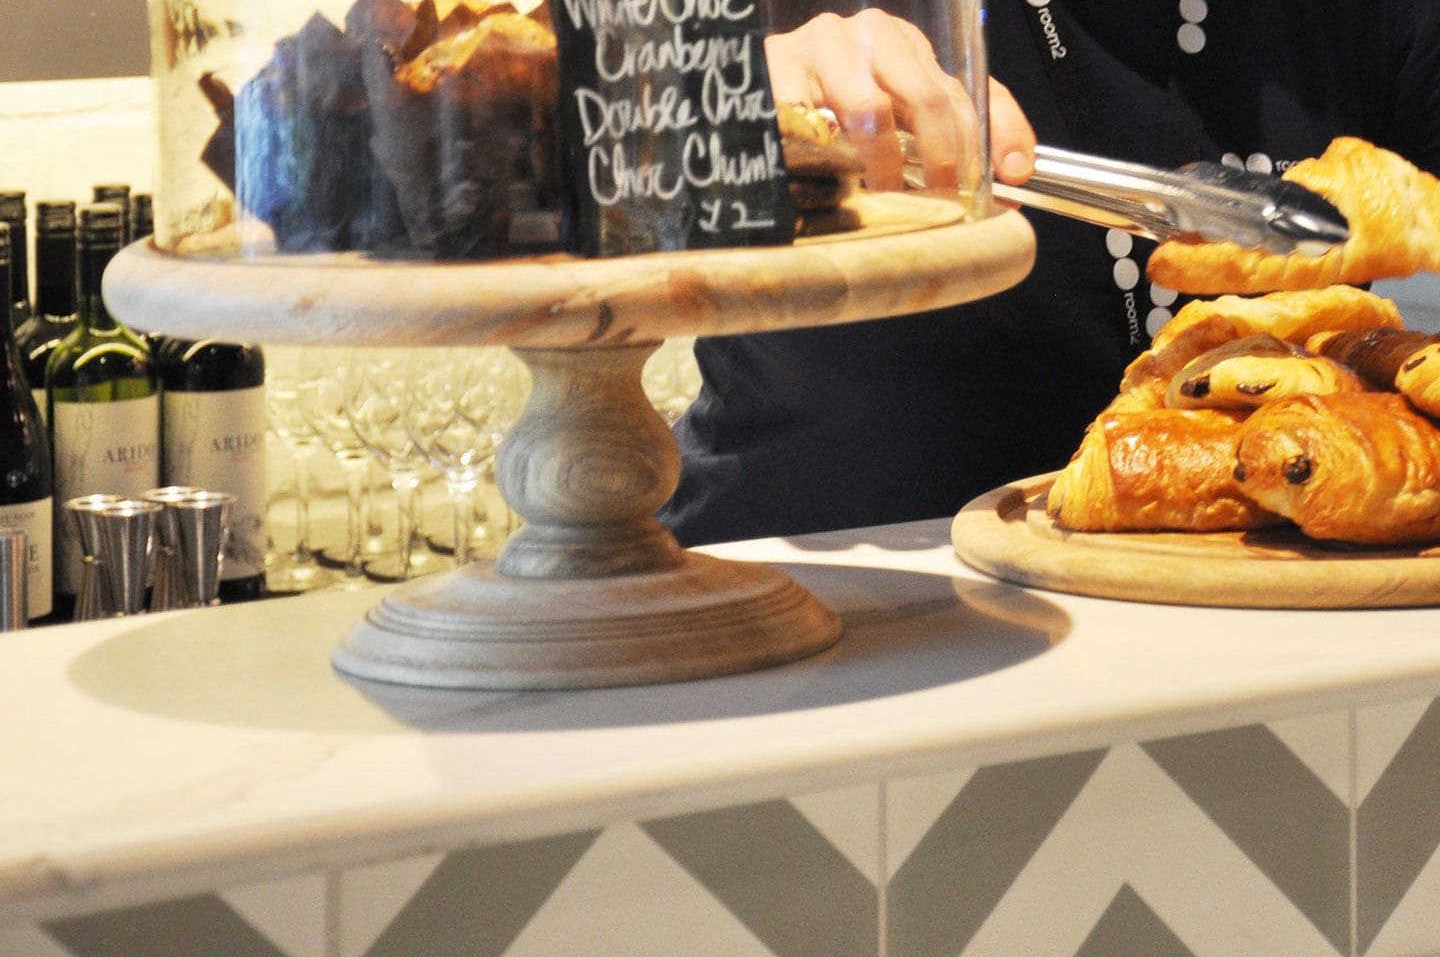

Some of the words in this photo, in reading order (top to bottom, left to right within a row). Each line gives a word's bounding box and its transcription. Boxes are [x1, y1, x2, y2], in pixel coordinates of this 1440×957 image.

[595, 23, 752, 94] Cranberry
[1038, 7, 1067, 61] room2
[574, 85, 698, 146] Double
[588, 143, 684, 206] Choc
[682, 131, 785, 187] Chunk
